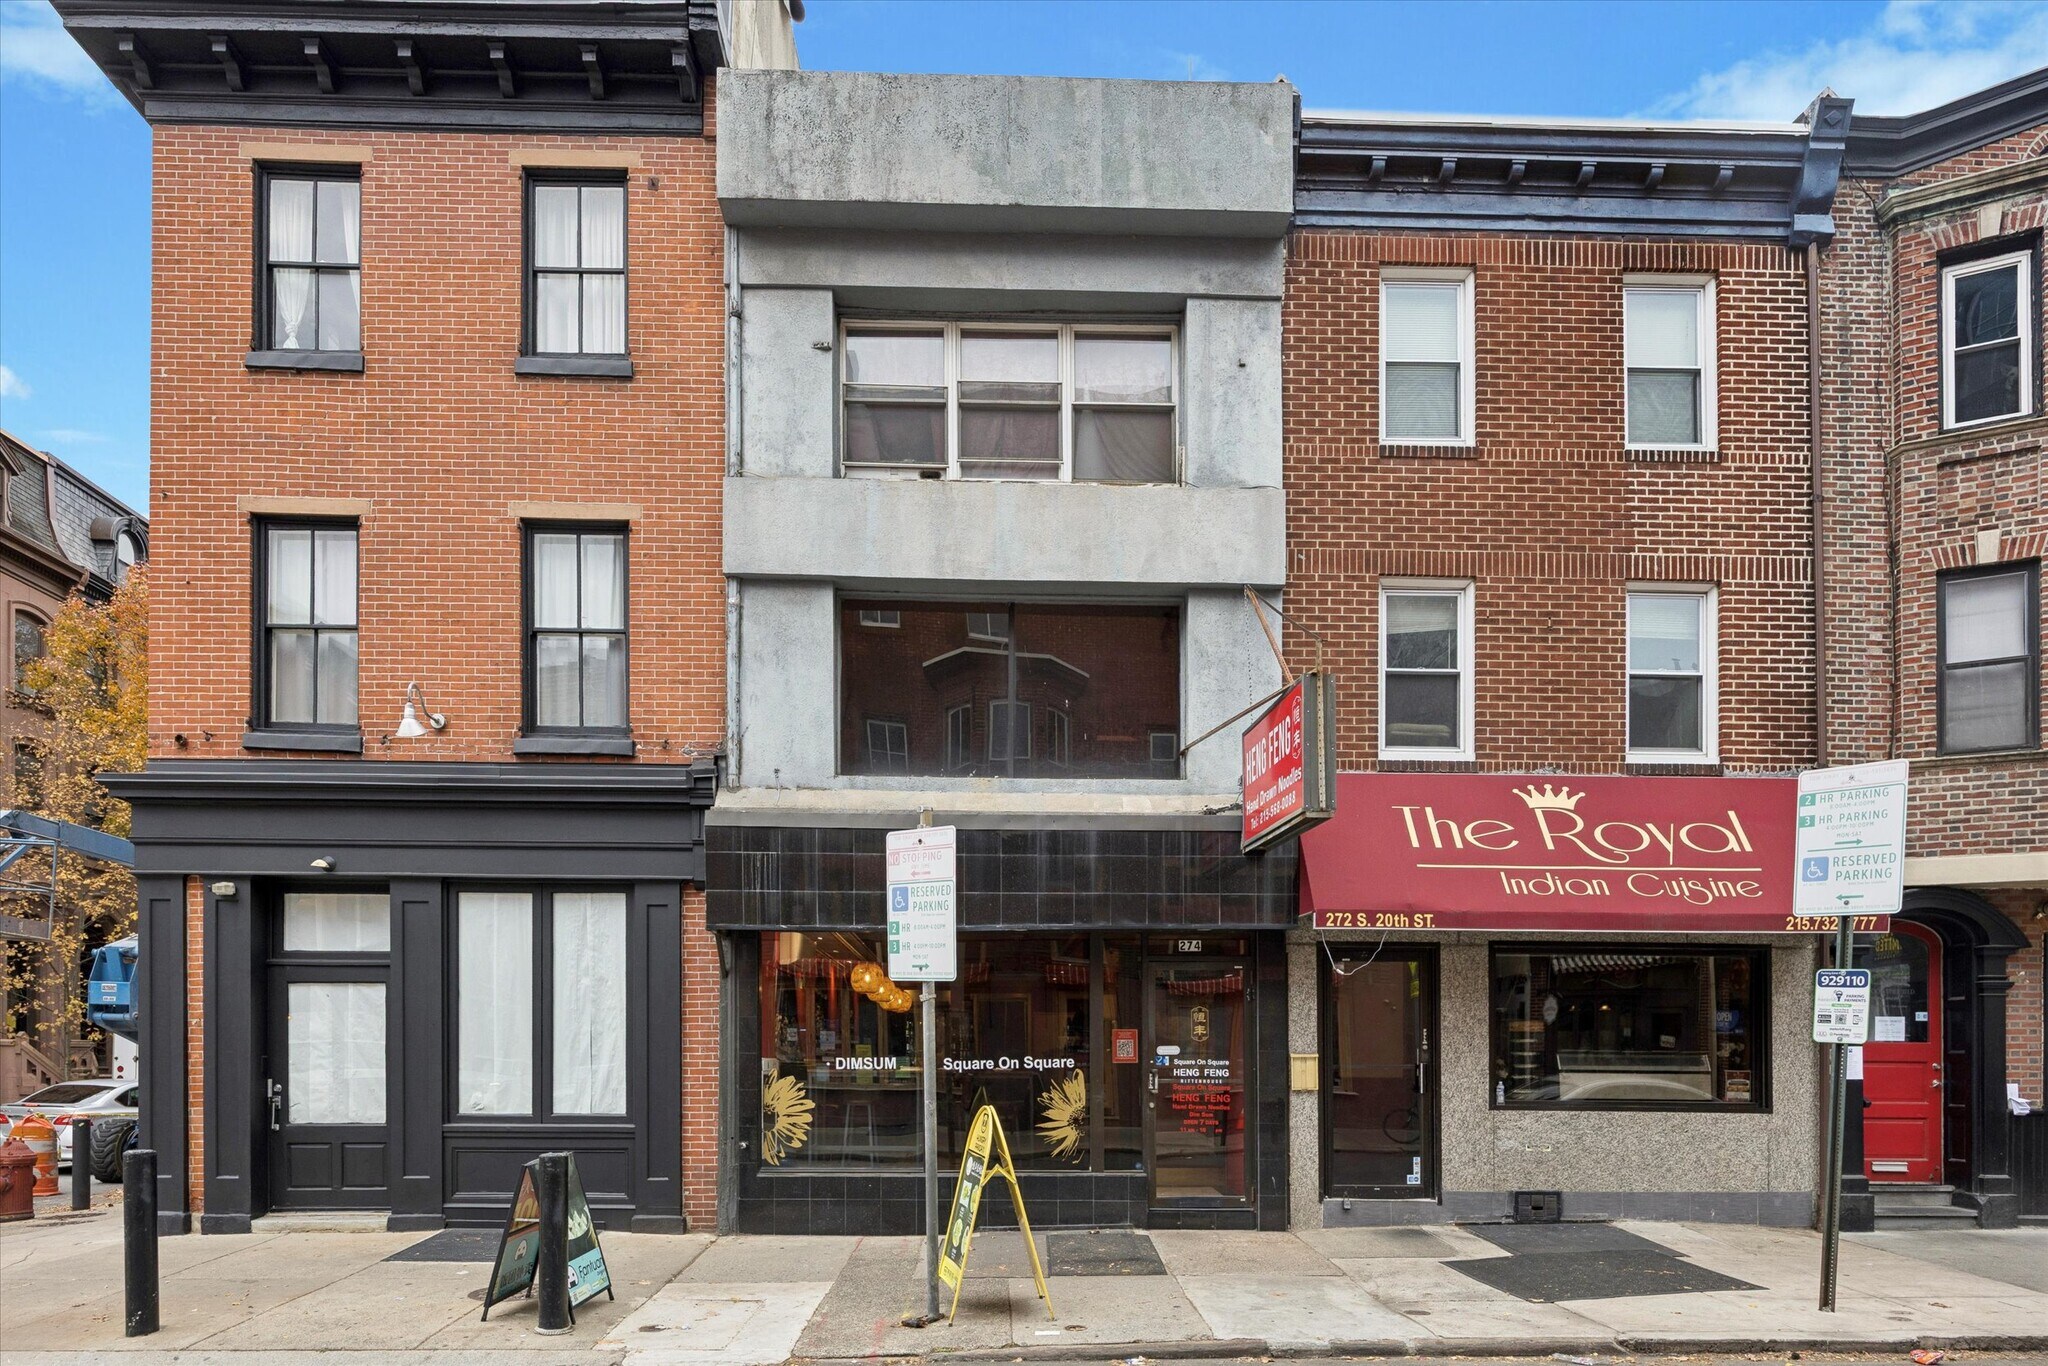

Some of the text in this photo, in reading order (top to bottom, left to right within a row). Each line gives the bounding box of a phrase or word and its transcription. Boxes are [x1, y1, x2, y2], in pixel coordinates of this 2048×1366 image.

[1246, 715, 1291, 786] HENG FENG
[1246, 766, 1302, 815] Hand Drawn Noodles
[1805, 787, 1890, 805] 2 HR PARKING
[1804, 809, 1888, 826] 3 HR PARKING
[1391, 805, 1754, 866] The Royal
[888, 851, 900, 867] NO
[1833, 852, 1897, 867] RESERVED
[1835, 867, 1893, 881] PARKING
[911, 884, 952, 898] RESERVED
[1500, 872, 1763, 906] Indian Cuisine
[913, 900, 949, 912] PARKING
[1325, 912, 1436, 928] 272 S. 20th ST.
[892, 923, 897, 933] 2
[901, 923, 911, 932] HR
[892, 942, 897, 952] 3
[901, 941, 911, 951] HR
[1179, 941, 1201, 951] 274
[1821, 975, 1865, 986] 929110
[835, 1057, 897, 1070] DIMSUM
[943, 1056, 1075, 1071] Square On Square
[1173, 1058, 1195, 1066] Square
[1207, 1059, 1230, 1067] Square
[1173, 1068, 1230, 1077] HENG FENG
[1207, 1084, 1231, 1092] Square
[1172, 1093, 1231, 1103] HENG FENG
